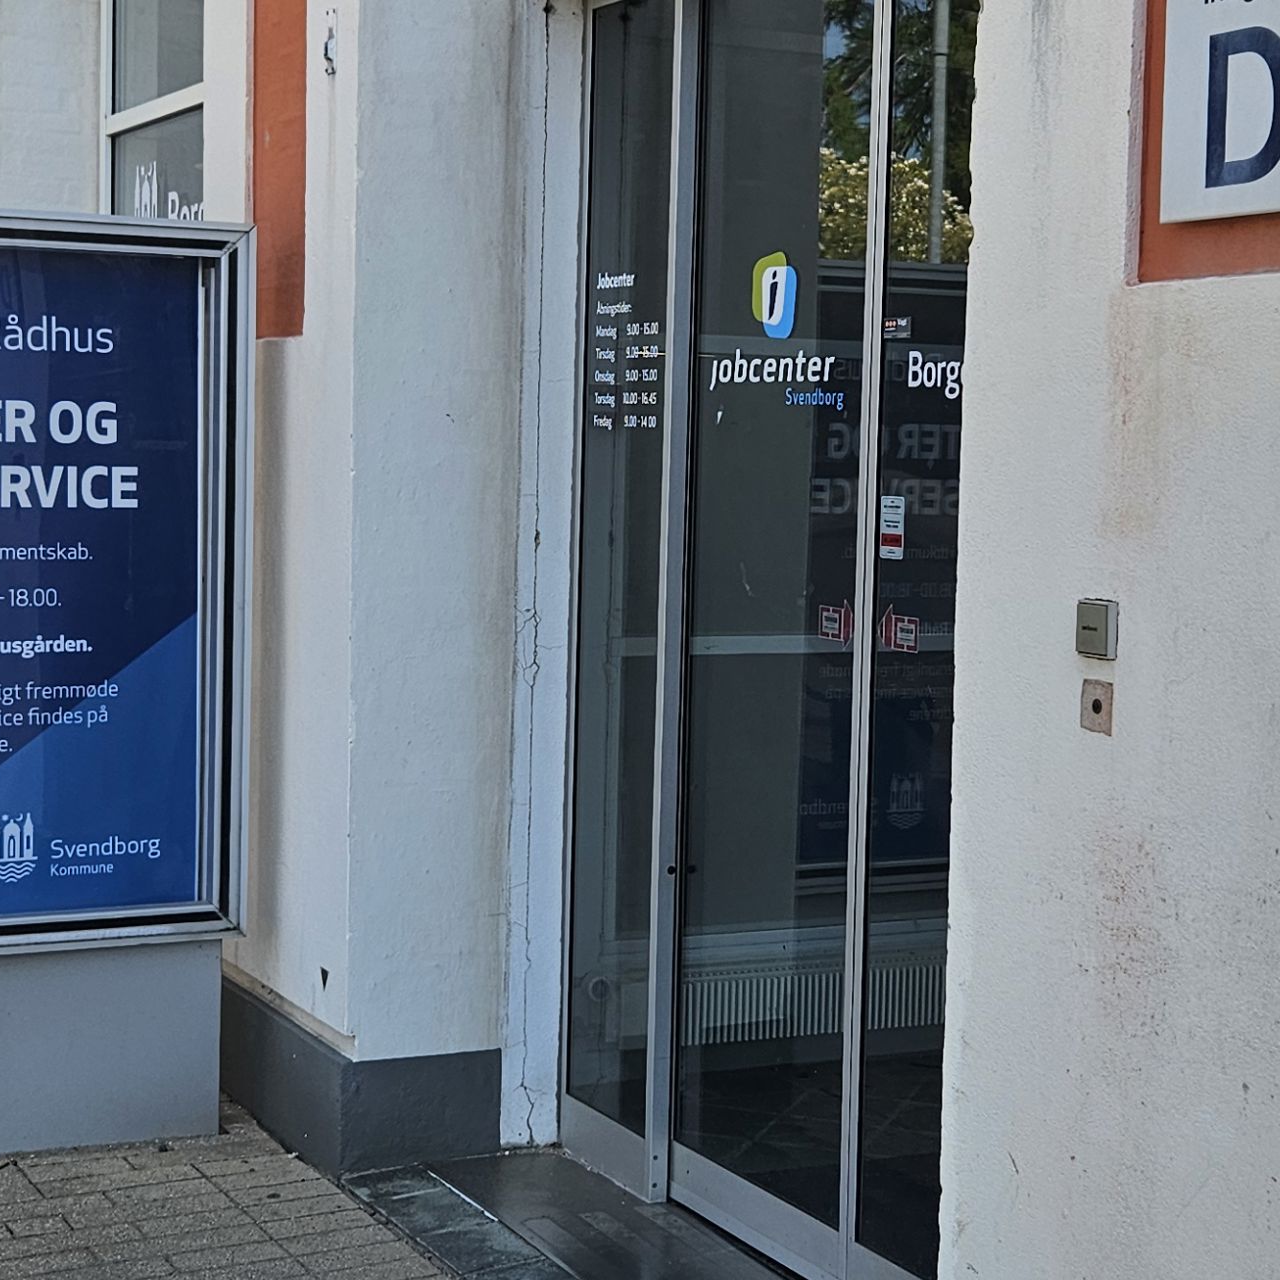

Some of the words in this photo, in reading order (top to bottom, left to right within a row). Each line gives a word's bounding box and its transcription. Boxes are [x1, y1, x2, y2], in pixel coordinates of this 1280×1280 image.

[596, 272, 635, 290] Jobcenter
[595, 325, 617, 340] Mandag
[595, 347, 615, 363] Tirsdag
[594, 369, 615, 385] Onsdag
[709, 348, 835, 391] jobcenter
[907, 350, 961, 400] Borg
[594, 392, 615, 408] Torsdag
[785, 387, 844, 411] Svendborg
[48, 400, 118, 444] OG
[593, 415, 612, 430] Fredag
[8, 588, 62, 607] 18.00.
[25, 679, 119, 701] fremmøde
[28, 706, 83, 726] findes
[87, 704, 109, 728] på
[50, 835, 161, 859] Svendborg
[50, 863, 114, 877] Kommune
